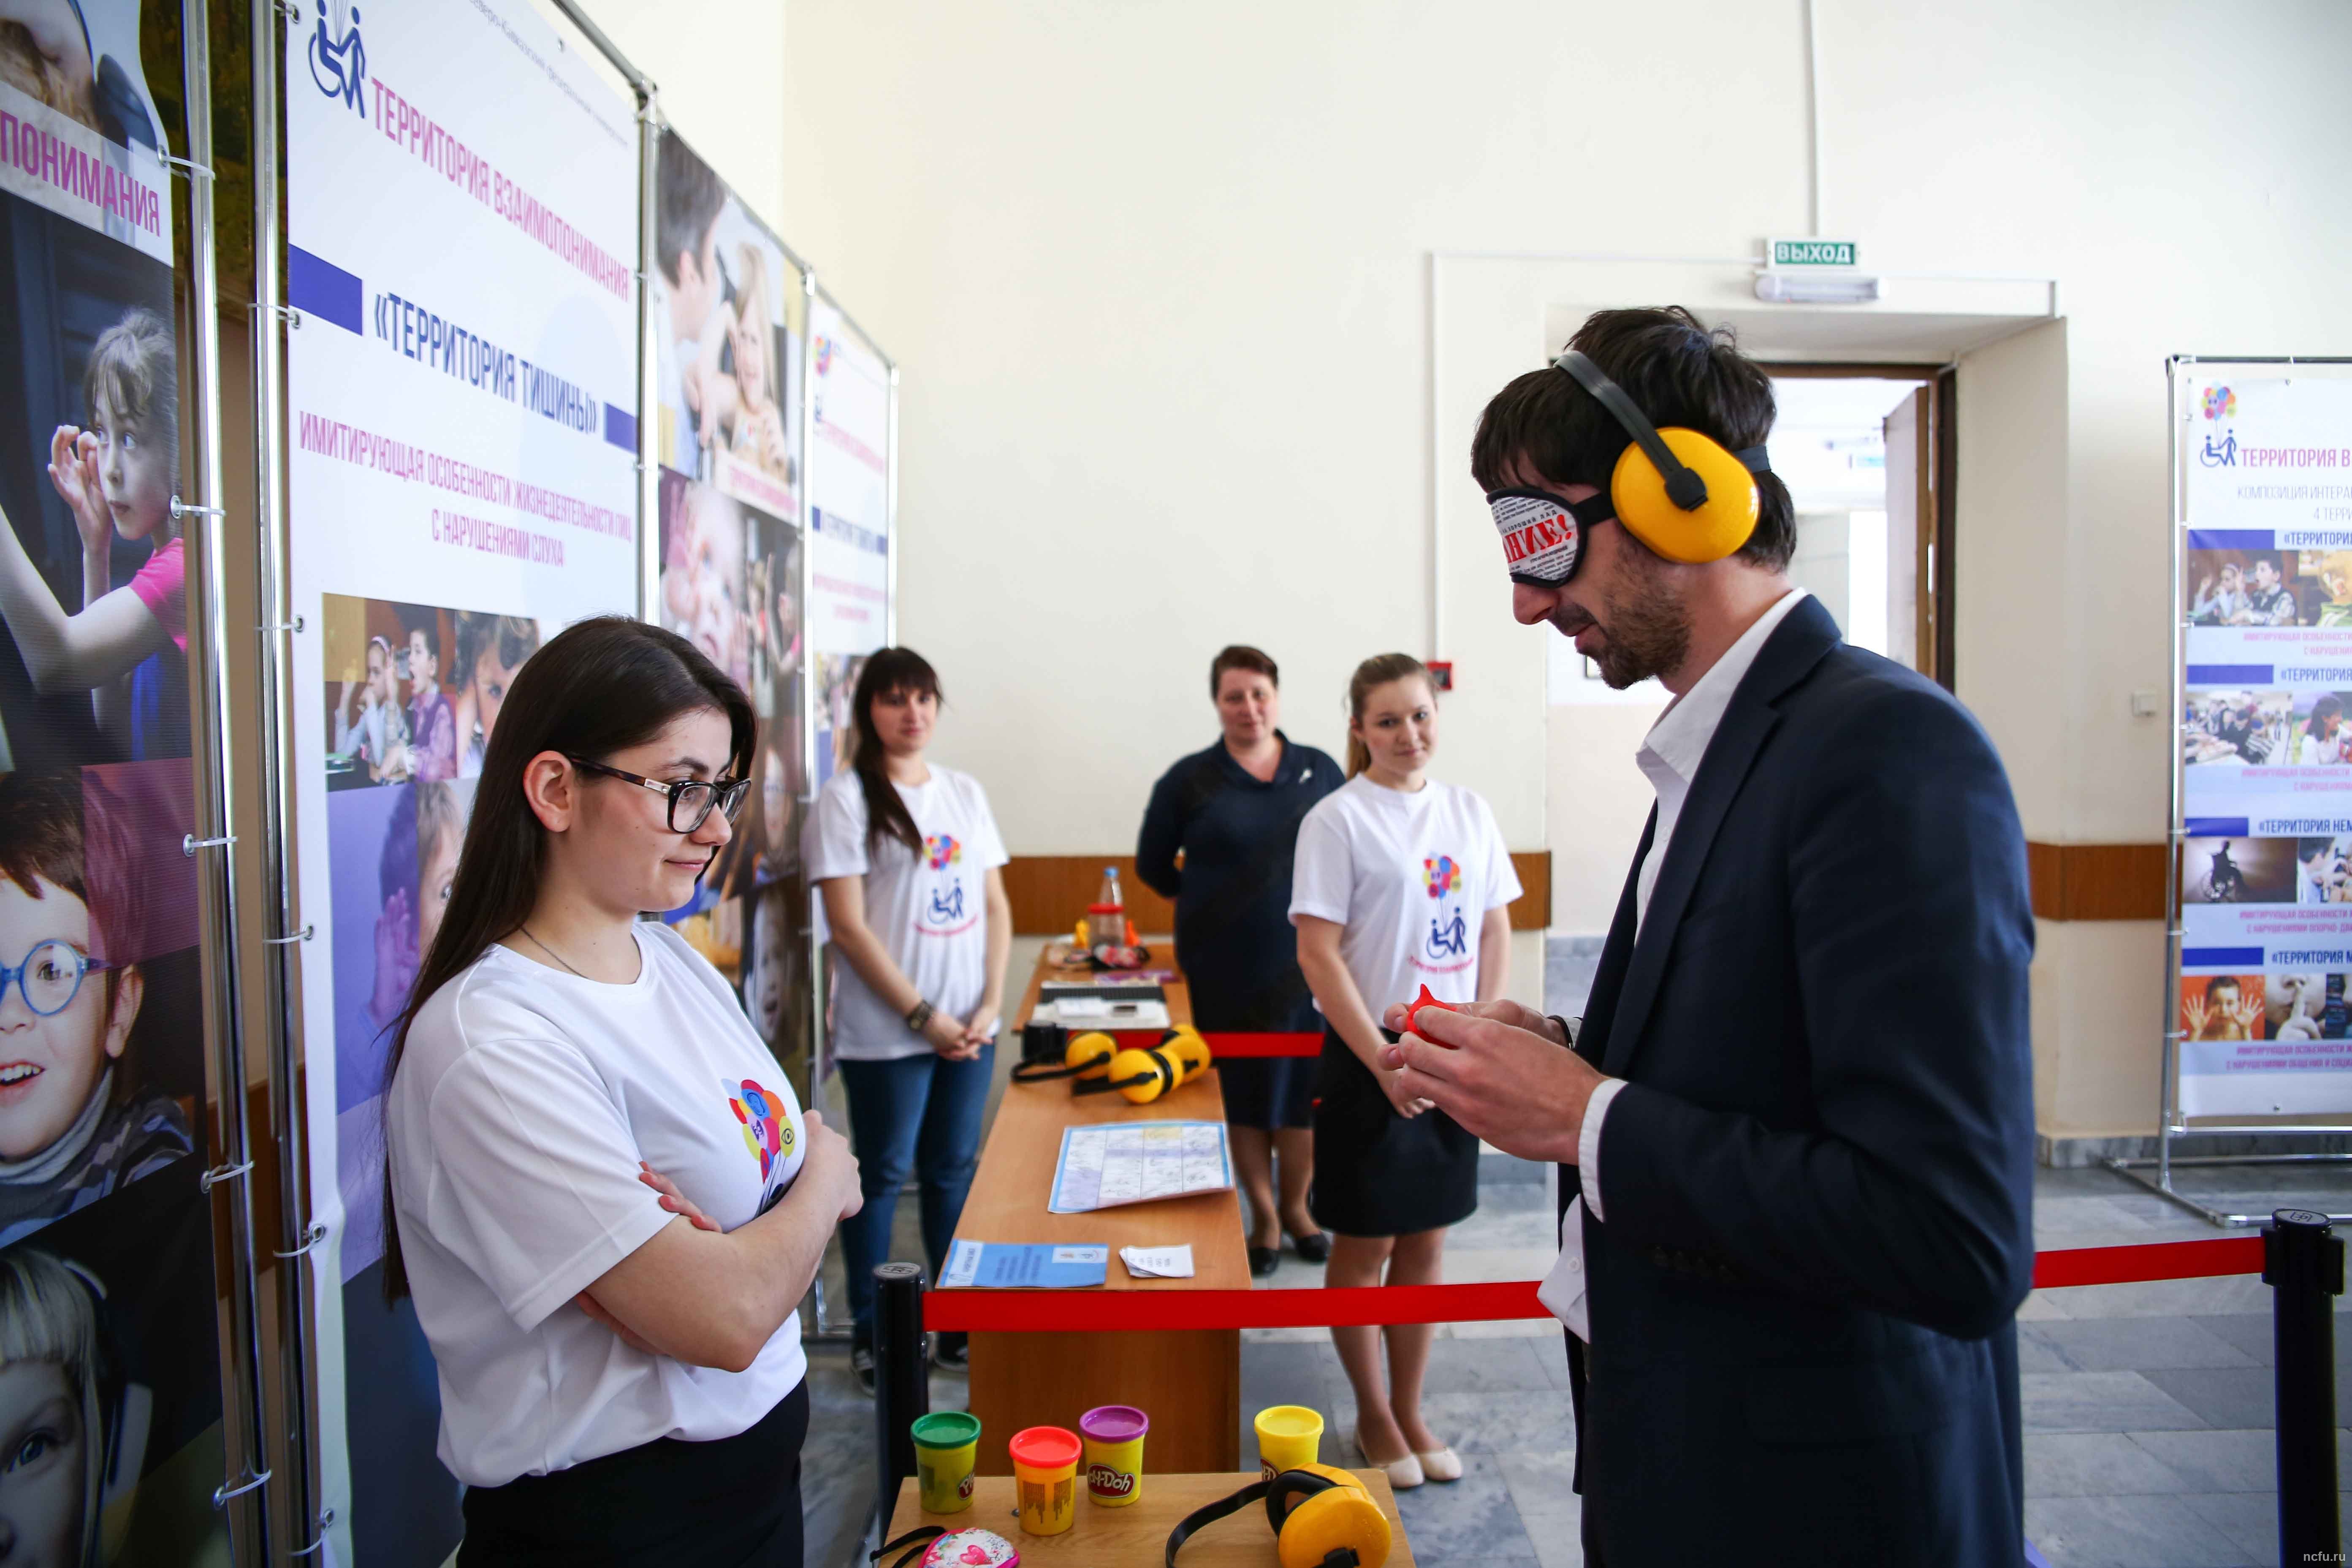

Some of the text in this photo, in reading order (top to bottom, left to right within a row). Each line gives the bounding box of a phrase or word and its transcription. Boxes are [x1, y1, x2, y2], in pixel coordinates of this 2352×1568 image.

[0, 109, 160, 237] ПОНИМАНИЯ
[372, 76, 629, 303] ТЕРРИТОРИЯ ВЗАИМОПОНИМАНИЯ
[1777, 244, 1851, 263] ВЫХОД
[374, 292, 596, 434] «ТЕРРИТОРИЯ ТИШИНЫ»
[2241, 449, 2352, 467] ТЕРРИТОРИЯ В
[299, 410, 631, 544] ИМИТИРУЮЩАЯ ОСОБЕННОСТИ ЖИЗНЕДЕЯТЕЛЬНОСТИ ЛИЦ
[2238, 486, 2308, 500] КОМПОЗИЦИЯ
[2314, 507, 2319, 521] 4
[432, 508, 564, 567] С НАРУШЕНИЯМИ СЛУХА
[2259, 819, 2330, 833] «ТЕРРИТОРИЯ
[2272, 951, 2343, 965] «ТЕРРИТОРИЯ
